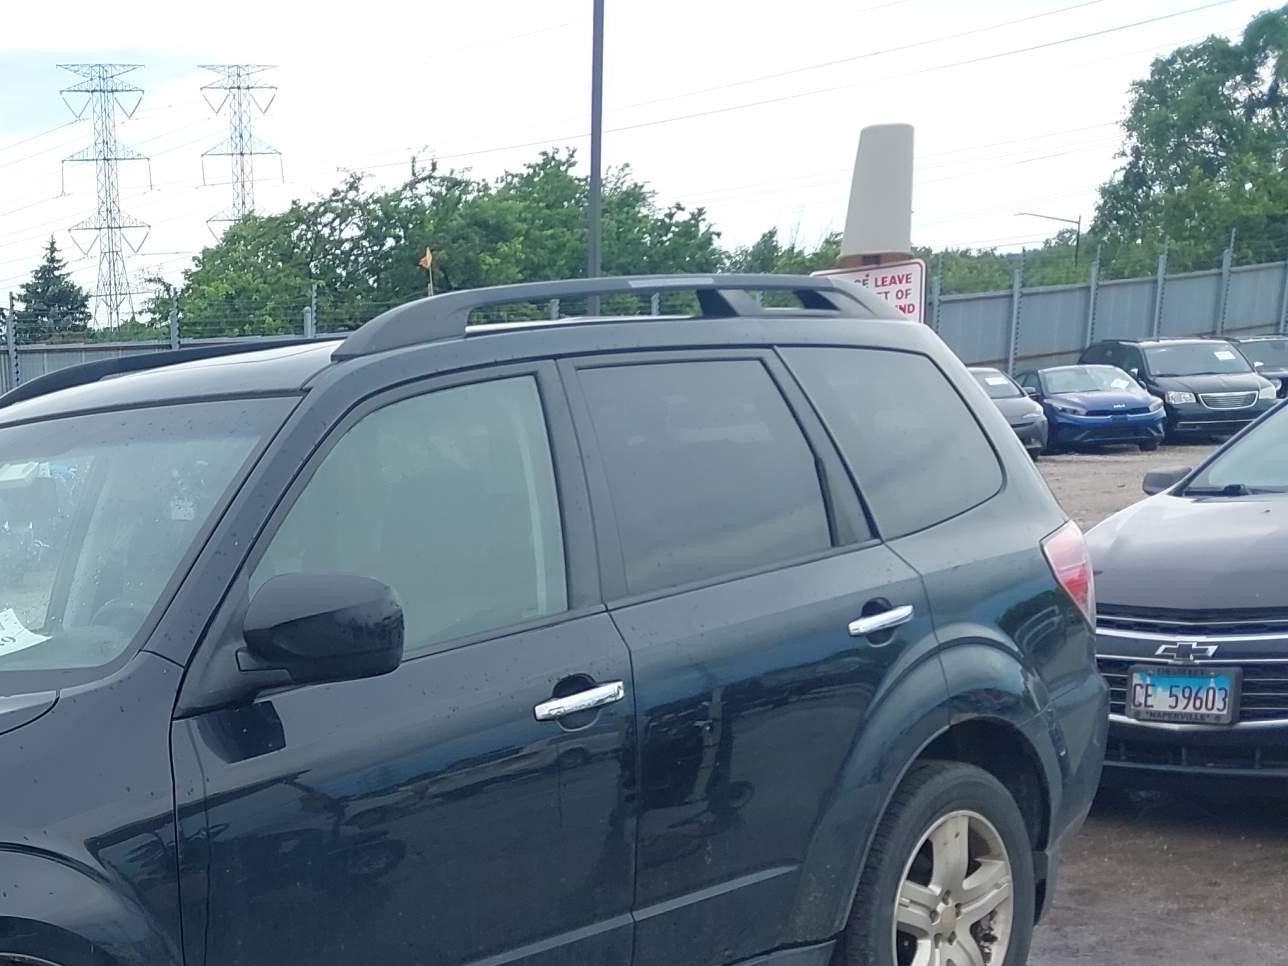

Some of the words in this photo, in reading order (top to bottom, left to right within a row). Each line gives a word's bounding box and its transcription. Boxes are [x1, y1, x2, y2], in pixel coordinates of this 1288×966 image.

[874, 273, 913, 288] LEAVE
[895, 288, 912, 300] OF
[1132, 683, 1156, 708] CE
[1168, 684, 1229, 712] 59603
